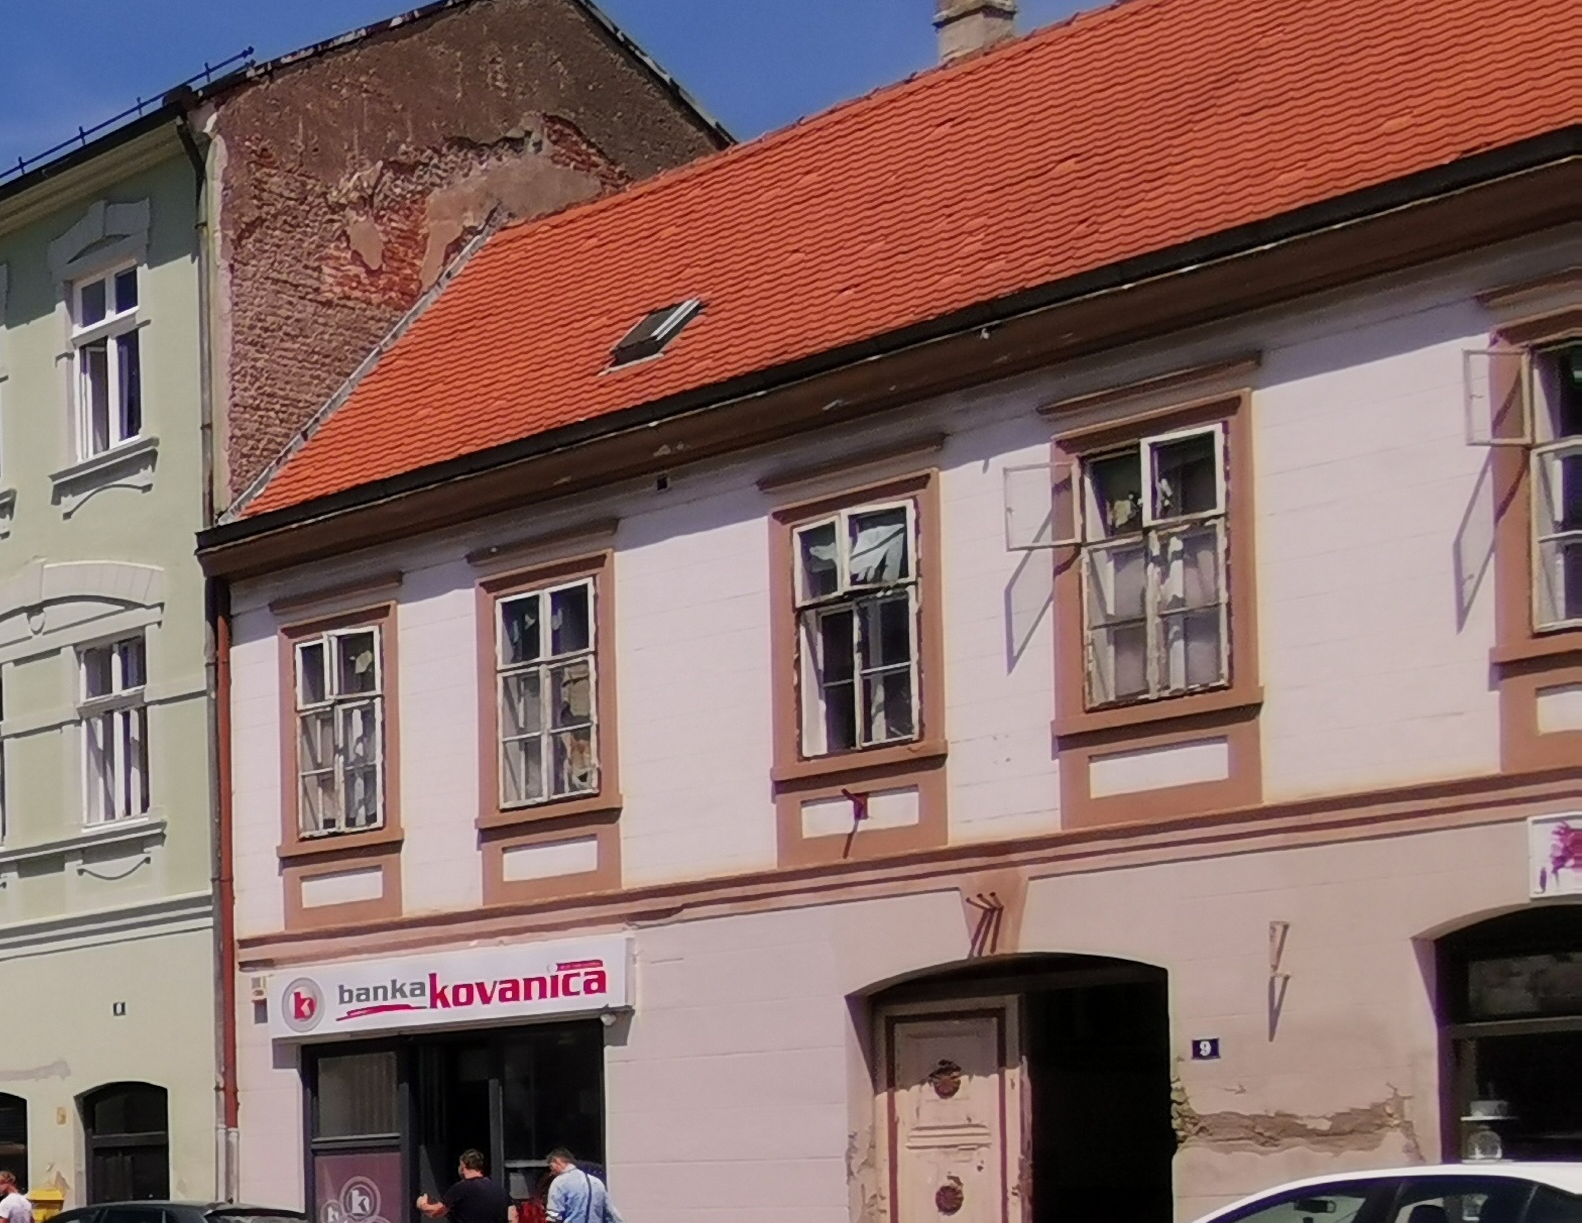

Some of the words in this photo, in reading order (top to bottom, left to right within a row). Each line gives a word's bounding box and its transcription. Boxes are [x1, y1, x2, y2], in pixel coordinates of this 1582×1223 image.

[338, 978, 426, 1005] banka
[428, 967, 608, 1009] kovanica
[1199, 1040, 1212, 1057] 9
